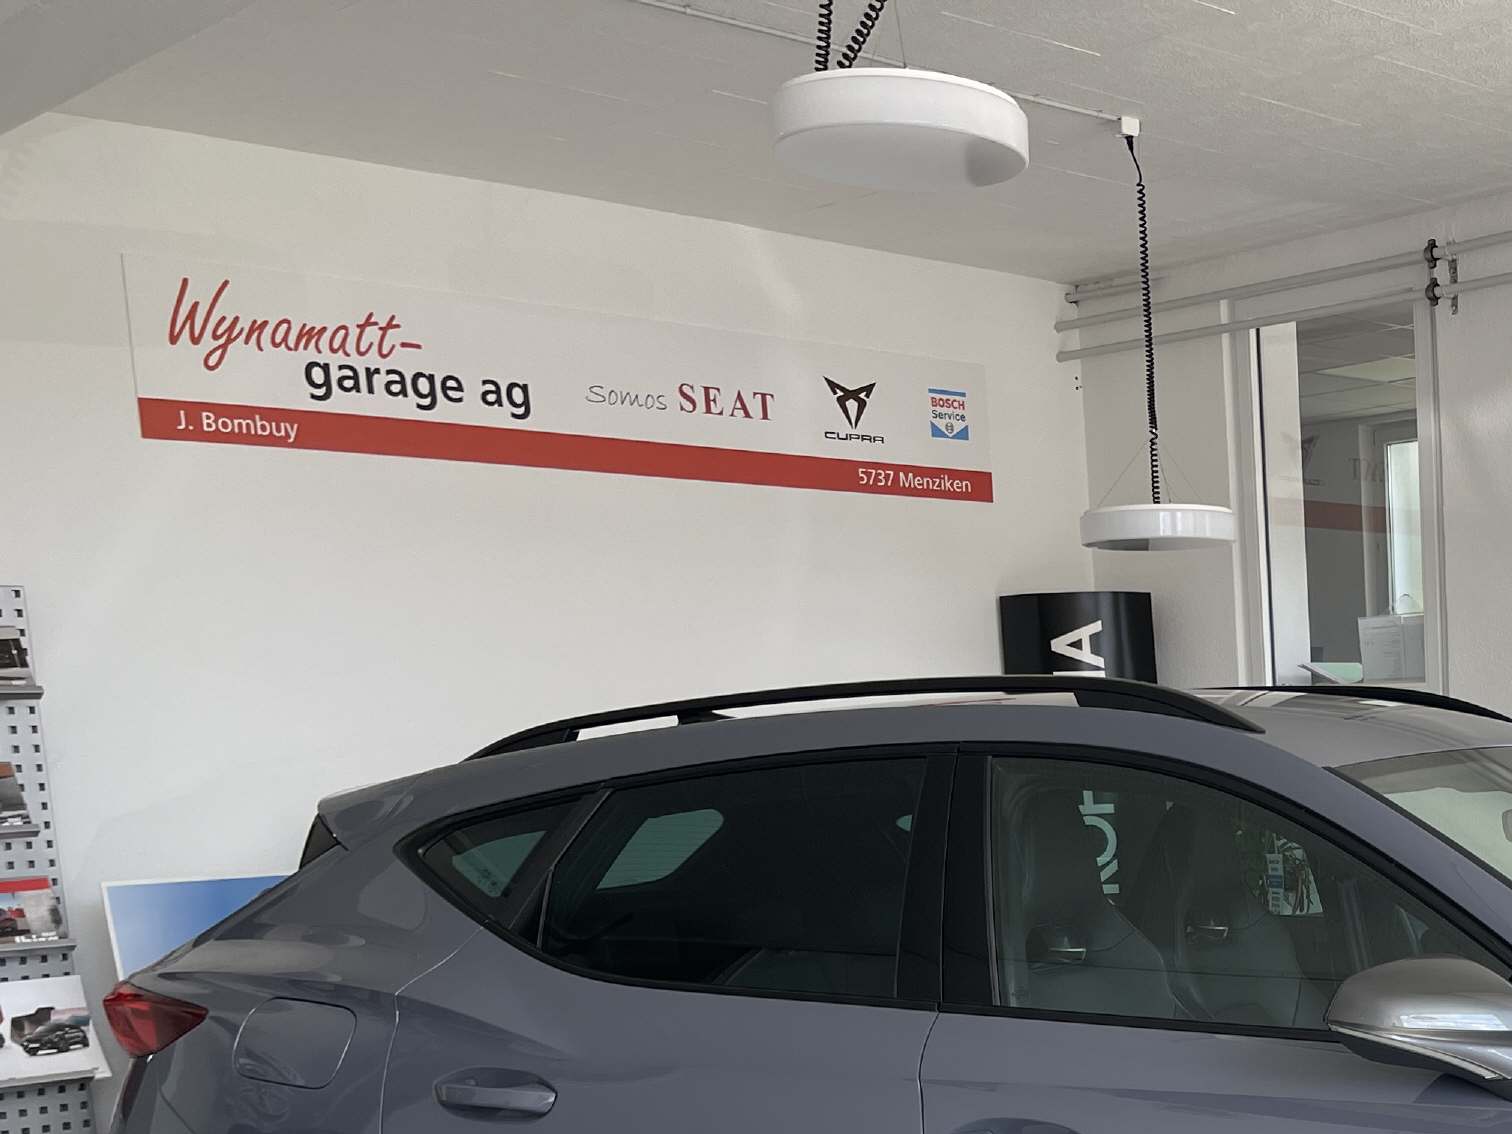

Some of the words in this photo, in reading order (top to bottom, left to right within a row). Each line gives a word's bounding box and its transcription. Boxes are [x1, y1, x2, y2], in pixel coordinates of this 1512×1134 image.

[168, 277, 422, 371] Wynamatt-
[304, 360, 465, 411] garage
[480, 377, 531, 420] ag
[585, 384, 668, 411] Somos
[677, 382, 776, 421] SEAT
[930, 396, 966, 411] BOSCH
[176, 409, 194, 430] J.
[201, 411, 298, 443] Bombuy
[931, 409, 966, 423] Service
[824, 431, 885, 445] CUPRA
[857, 467, 895, 487] 5737
[899, 471, 972, 493] Menziken
